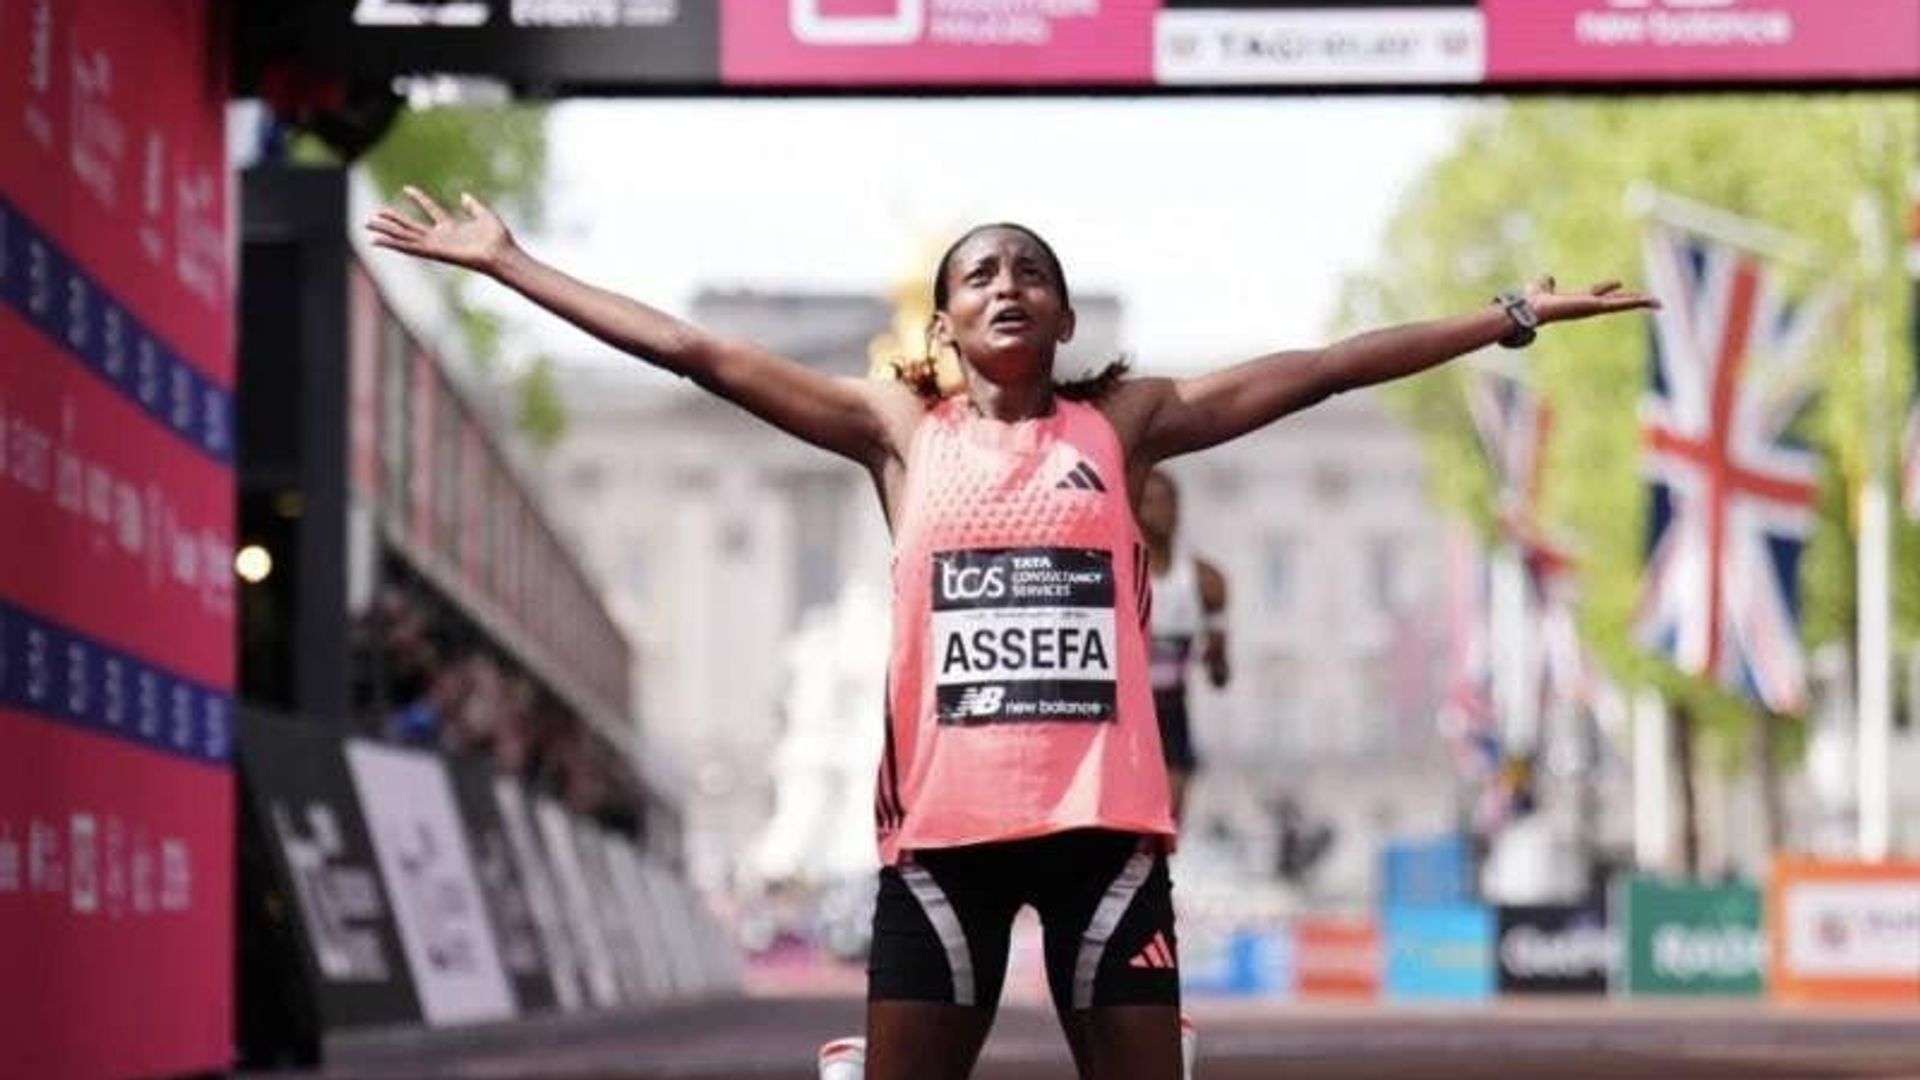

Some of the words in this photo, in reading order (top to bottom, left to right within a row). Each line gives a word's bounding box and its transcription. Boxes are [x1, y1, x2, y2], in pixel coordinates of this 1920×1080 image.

[1012, 556, 1051, 568] TATA
[1012, 584, 1070, 597] SERVICES
[943, 627, 1109, 673] ASSEFA
[1005, 701, 1036, 715] new
